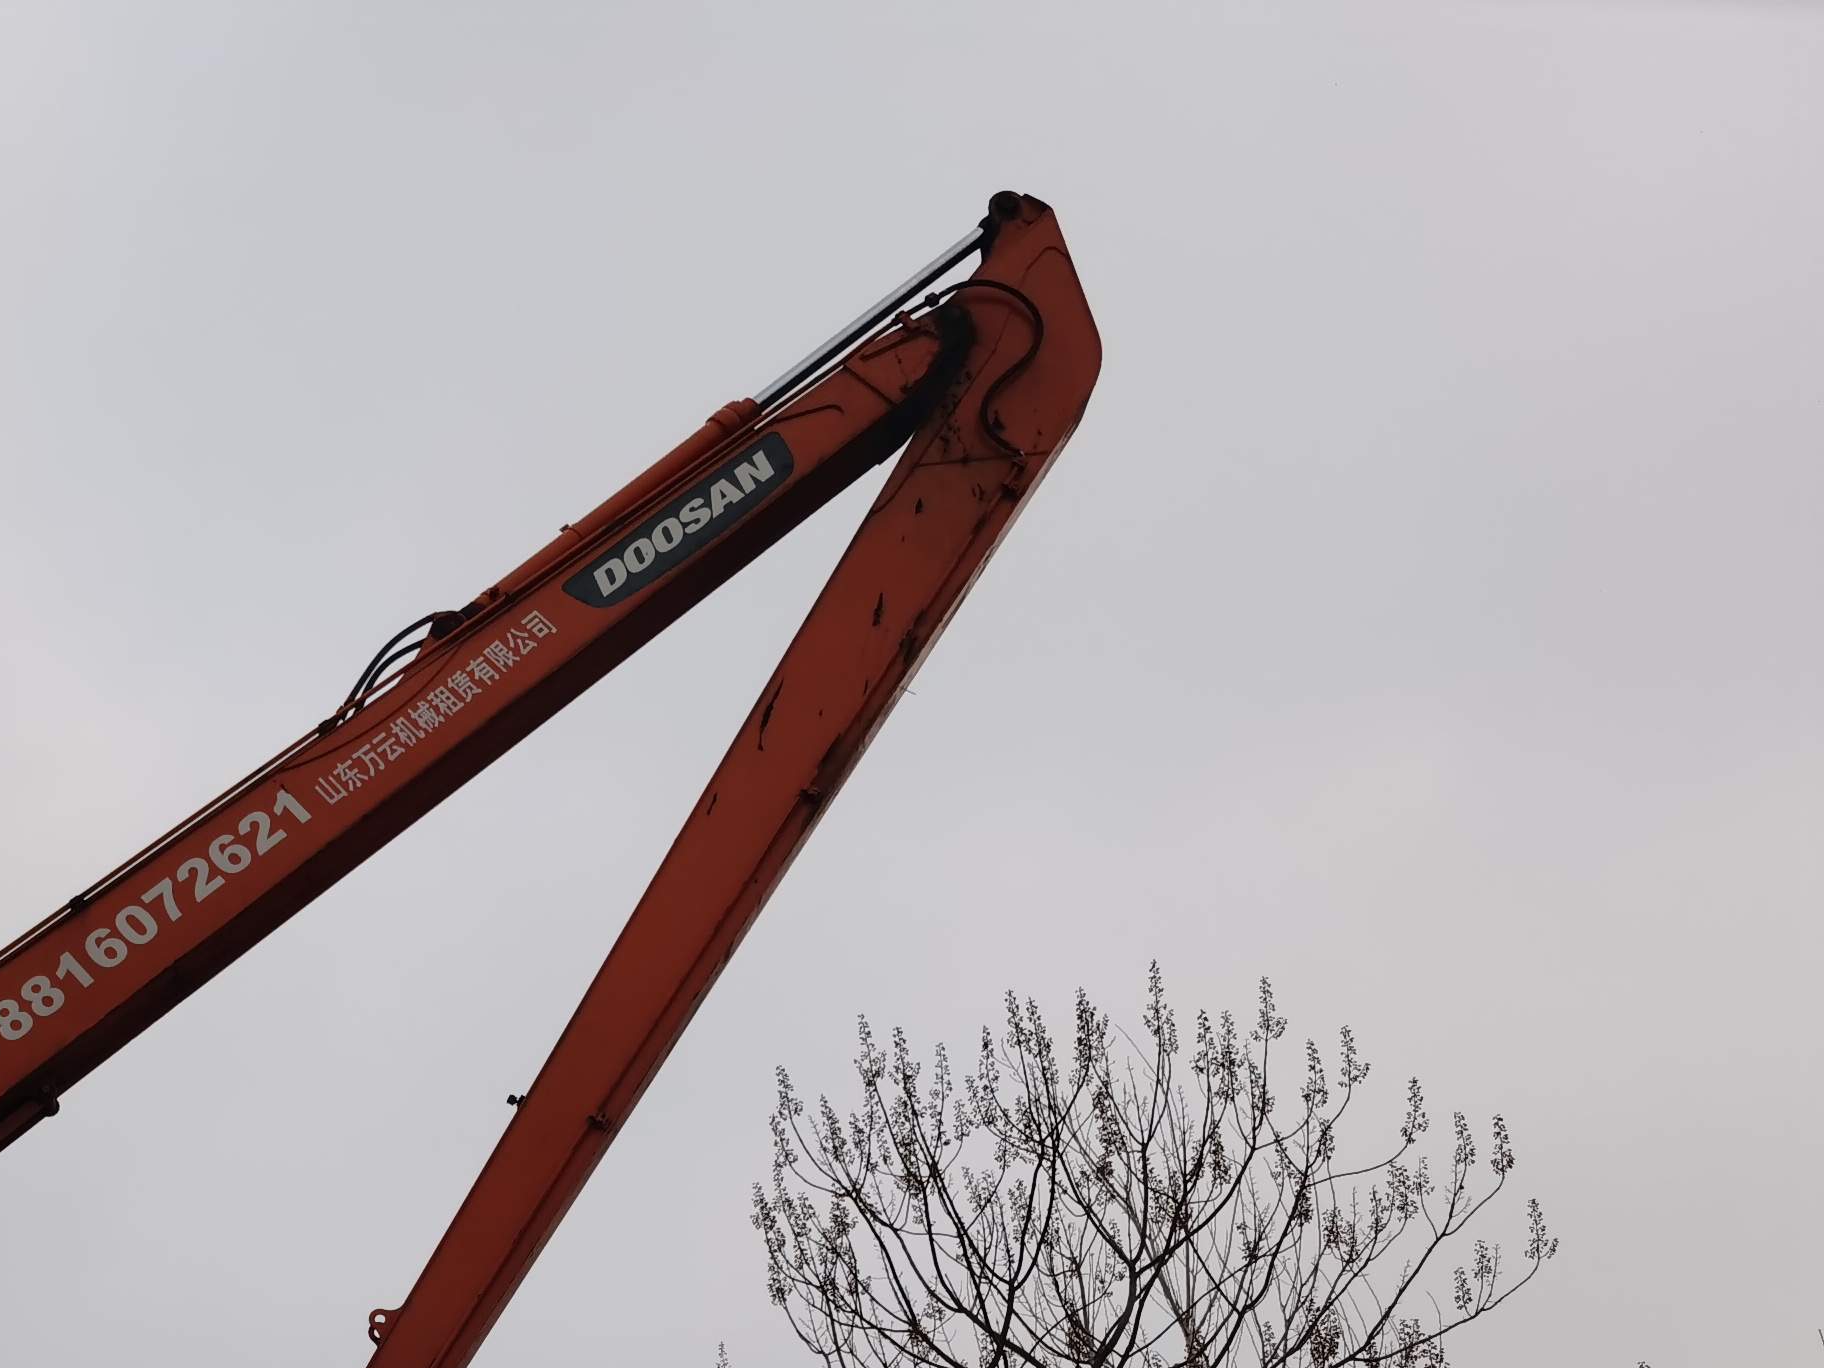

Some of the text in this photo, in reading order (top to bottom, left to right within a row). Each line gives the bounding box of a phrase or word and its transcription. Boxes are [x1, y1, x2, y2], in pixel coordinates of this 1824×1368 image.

[592, 449, 776, 598] DOOSAN
[314, 609, 558, 805] 山东万云机械租赁有限公司
